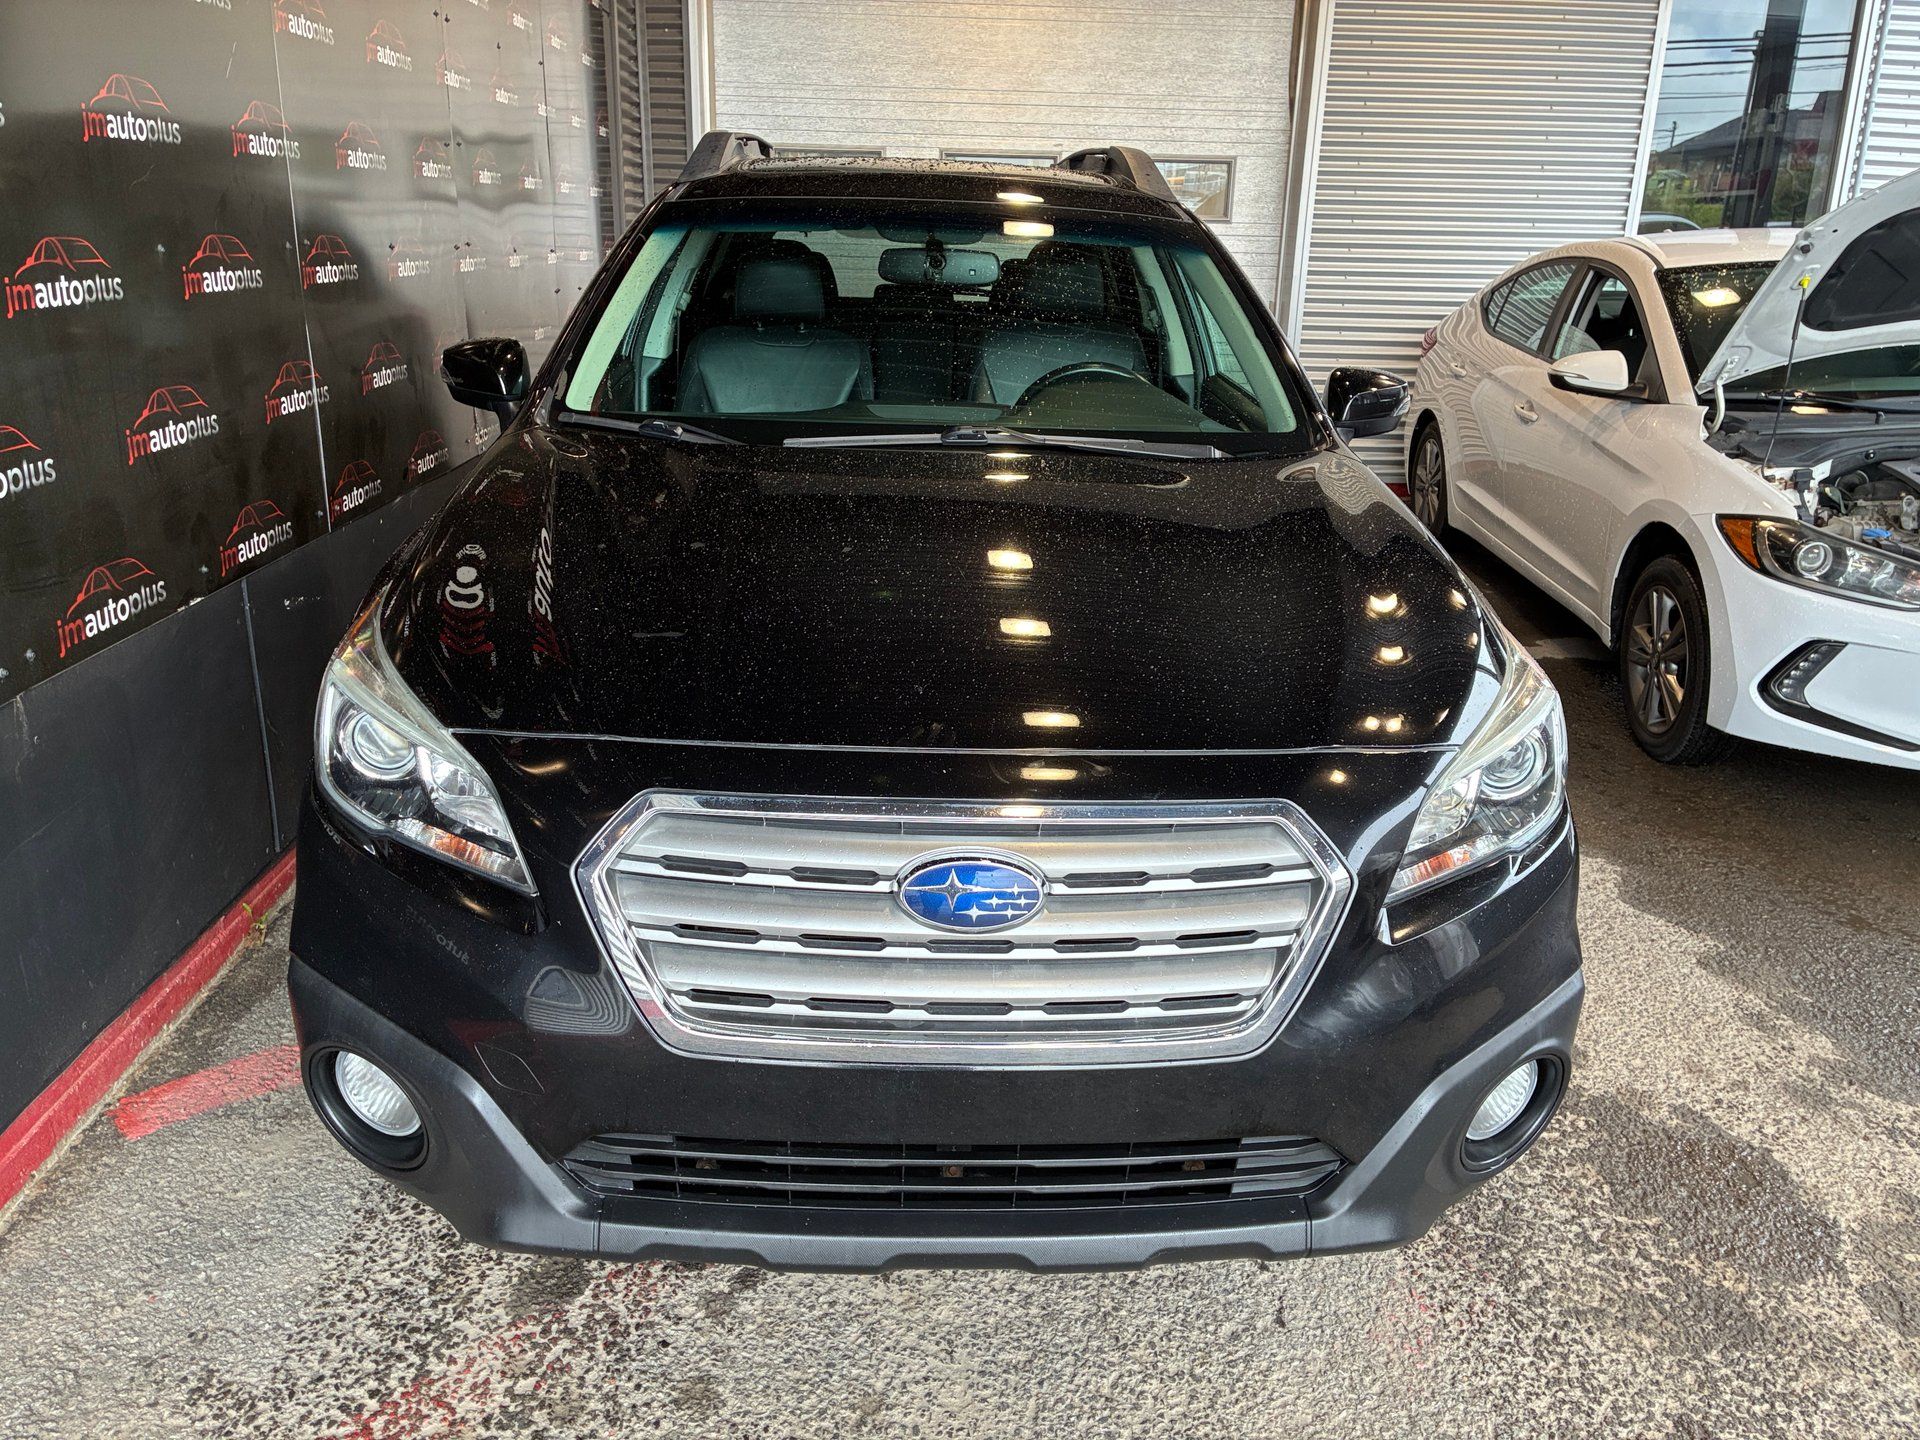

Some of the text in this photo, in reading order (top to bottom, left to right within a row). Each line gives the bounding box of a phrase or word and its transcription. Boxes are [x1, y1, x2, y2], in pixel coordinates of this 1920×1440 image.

[274, 4, 334, 45] jmautoplus
[365, 36, 413, 72] jmautoplus
[81, 102, 182, 145] jmautoplus
[231, 125, 301, 160] jmautoplus
[335, 143, 387, 171] jmautoplus
[182, 266, 264, 300] jmautoplus
[302, 260, 359, 291] jmautoplus
[5, 274, 124, 319] jmautoplus
[361, 362, 409, 396] jmautoplus
[265, 384, 330, 425] jmautoplus
[126, 413, 220, 465] jmautoplus
[330, 478, 383, 523] jmautoplus
[219, 520, 294, 577] jmautoplus
[57, 579, 168, 658] jmautoplus
